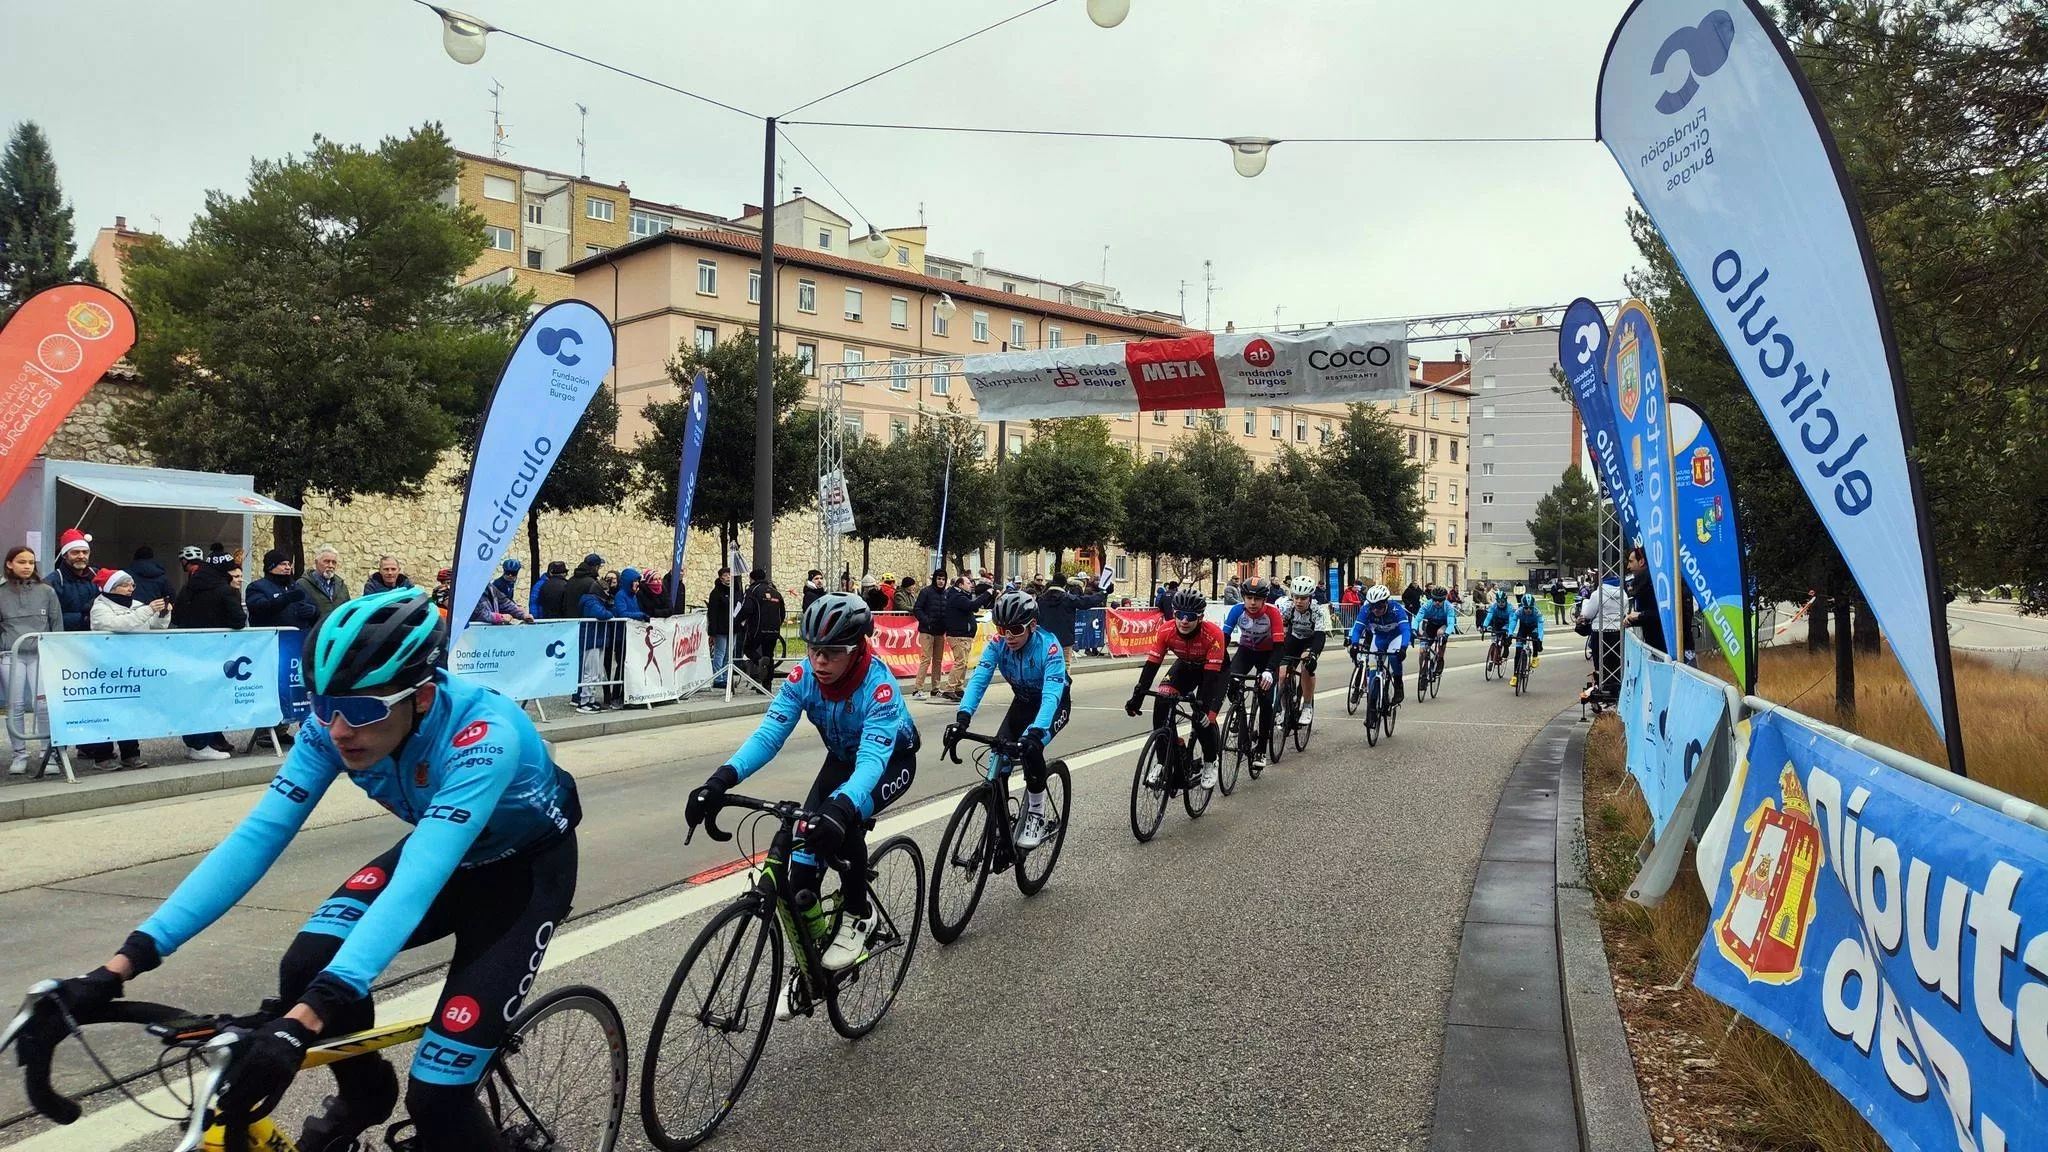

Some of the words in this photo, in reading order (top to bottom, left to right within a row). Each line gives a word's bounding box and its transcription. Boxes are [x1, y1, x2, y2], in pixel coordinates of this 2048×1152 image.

[1250, 348, 1270, 361] ab
[552, 368, 590, 386] Fundación
[1079, 367, 1117, 376] Grúas
[1141, 361, 1206, 381] META
[1239, 368, 1293, 377] andamios
[1325, 372, 1378, 380] RESTAURANTE
[1083, 378, 1127, 387] Bellver
[1248, 378, 1287, 387] burgos
[549, 388, 576, 402] Burgos
[871, 627, 921, 648] BUR
[456, 650, 481, 659] Donde
[482, 650, 491, 658] el
[492, 649, 516, 658] futuro
[457, 662, 475, 671] toma
[476, 661, 499, 670] forma
[62, 667, 107, 681] Donde
[110, 668, 124, 679] el
[127, 665, 168, 678] futuro
[63, 685, 97, 696] toma
[100, 682, 141, 695] forma
[865, 733, 893, 746] CCB
[351, 872, 378, 884] ab
[446, 1006, 472, 1024] ab
[420, 1041, 478, 1068] CCB
